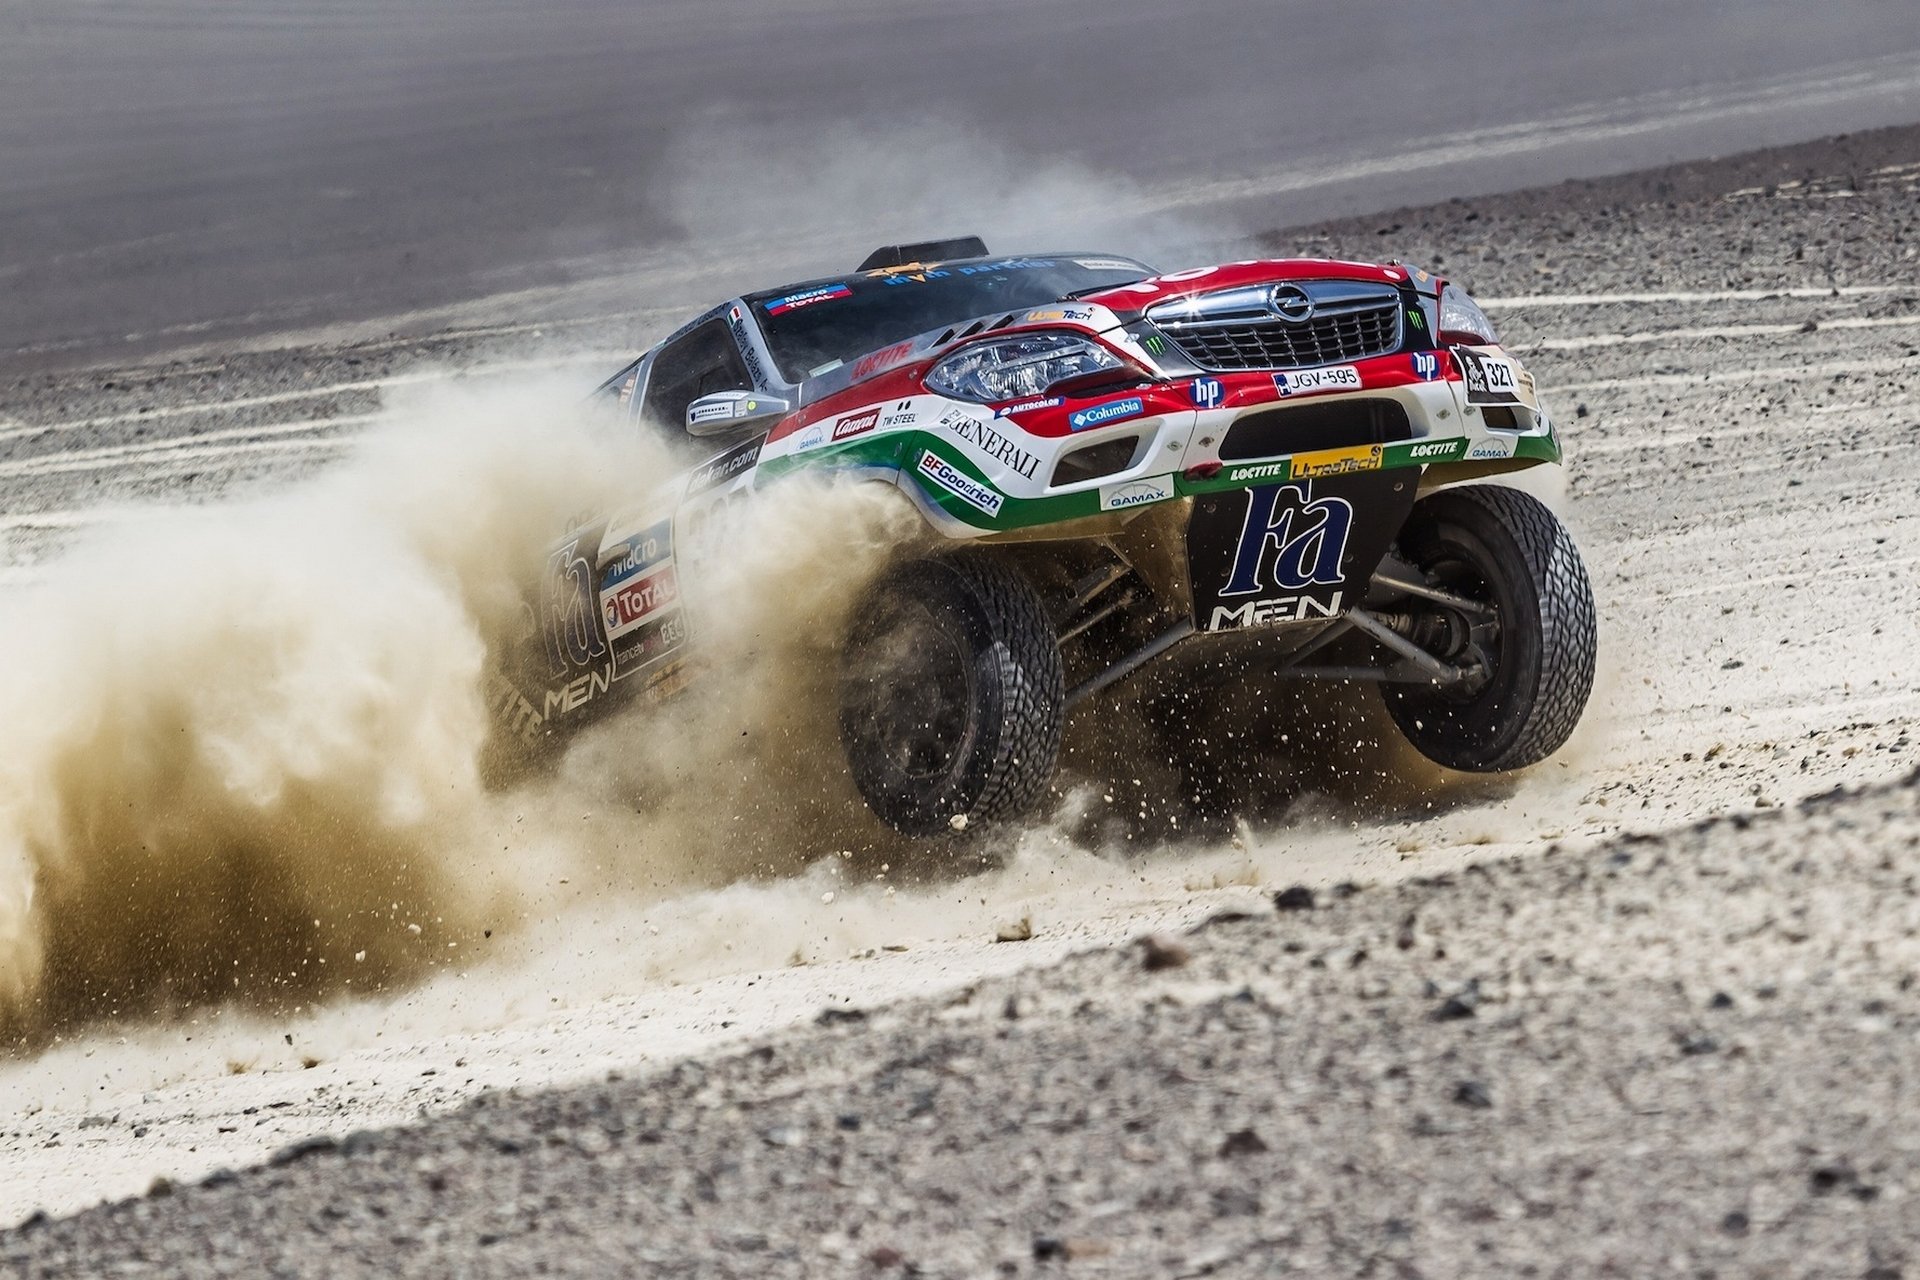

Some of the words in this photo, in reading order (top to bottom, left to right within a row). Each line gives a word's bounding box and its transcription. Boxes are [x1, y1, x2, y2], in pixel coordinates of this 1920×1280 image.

[784, 288, 828, 303] Macro
[785, 294, 835, 309] TOTAL
[1412, 351, 1436, 382] hp
[1487, 362, 1514, 388] 327
[1292, 369, 1358, 390] JGV-595
[1194, 377, 1219, 409] hp
[1012, 397, 1059, 413] AUTOCOLOR
[1085, 400, 1139, 422] Columbia
[834, 413, 879, 437] Carrera
[893, 412, 917, 426] STEEL
[948, 414, 1043, 481] GENERALI
[1410, 441, 1458, 458] LOCTITE
[1471, 448, 1510, 458] GAMAX
[922, 454, 1001, 510] BFGoodrich
[1230, 463, 1281, 481] LOCTITE
[1110, 490, 1166, 508] GAMAX
[1218, 479, 1354, 597] Fa
[619, 579, 675, 618] TOTAL
[1208, 591, 1343, 632] MEN
[544, 663, 611, 721] MEN
